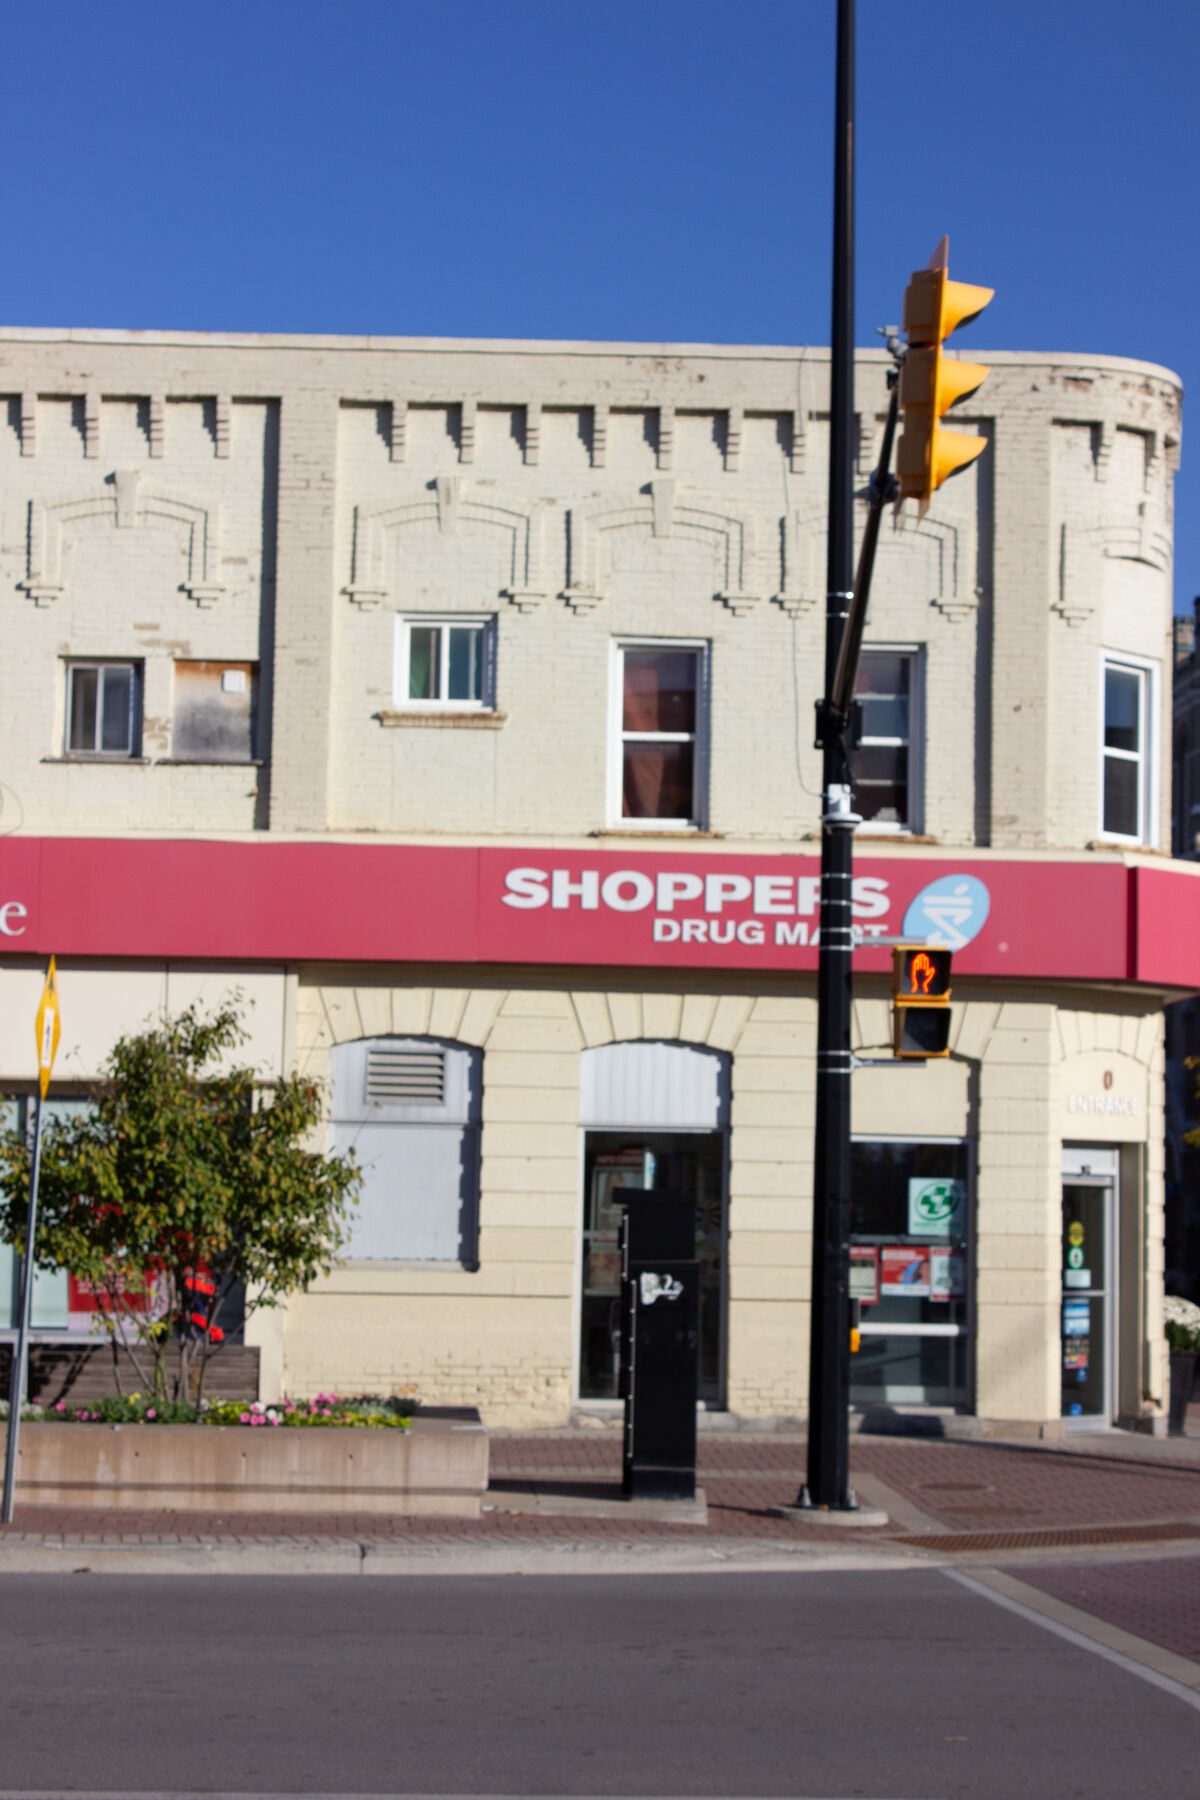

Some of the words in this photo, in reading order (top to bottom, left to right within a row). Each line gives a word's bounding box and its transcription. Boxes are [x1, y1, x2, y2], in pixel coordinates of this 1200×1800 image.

[653, 918, 765, 945] DRUG
[775, 921, 888, 947] MT
[1067, 1095, 1141, 1116] ENTRANCE
